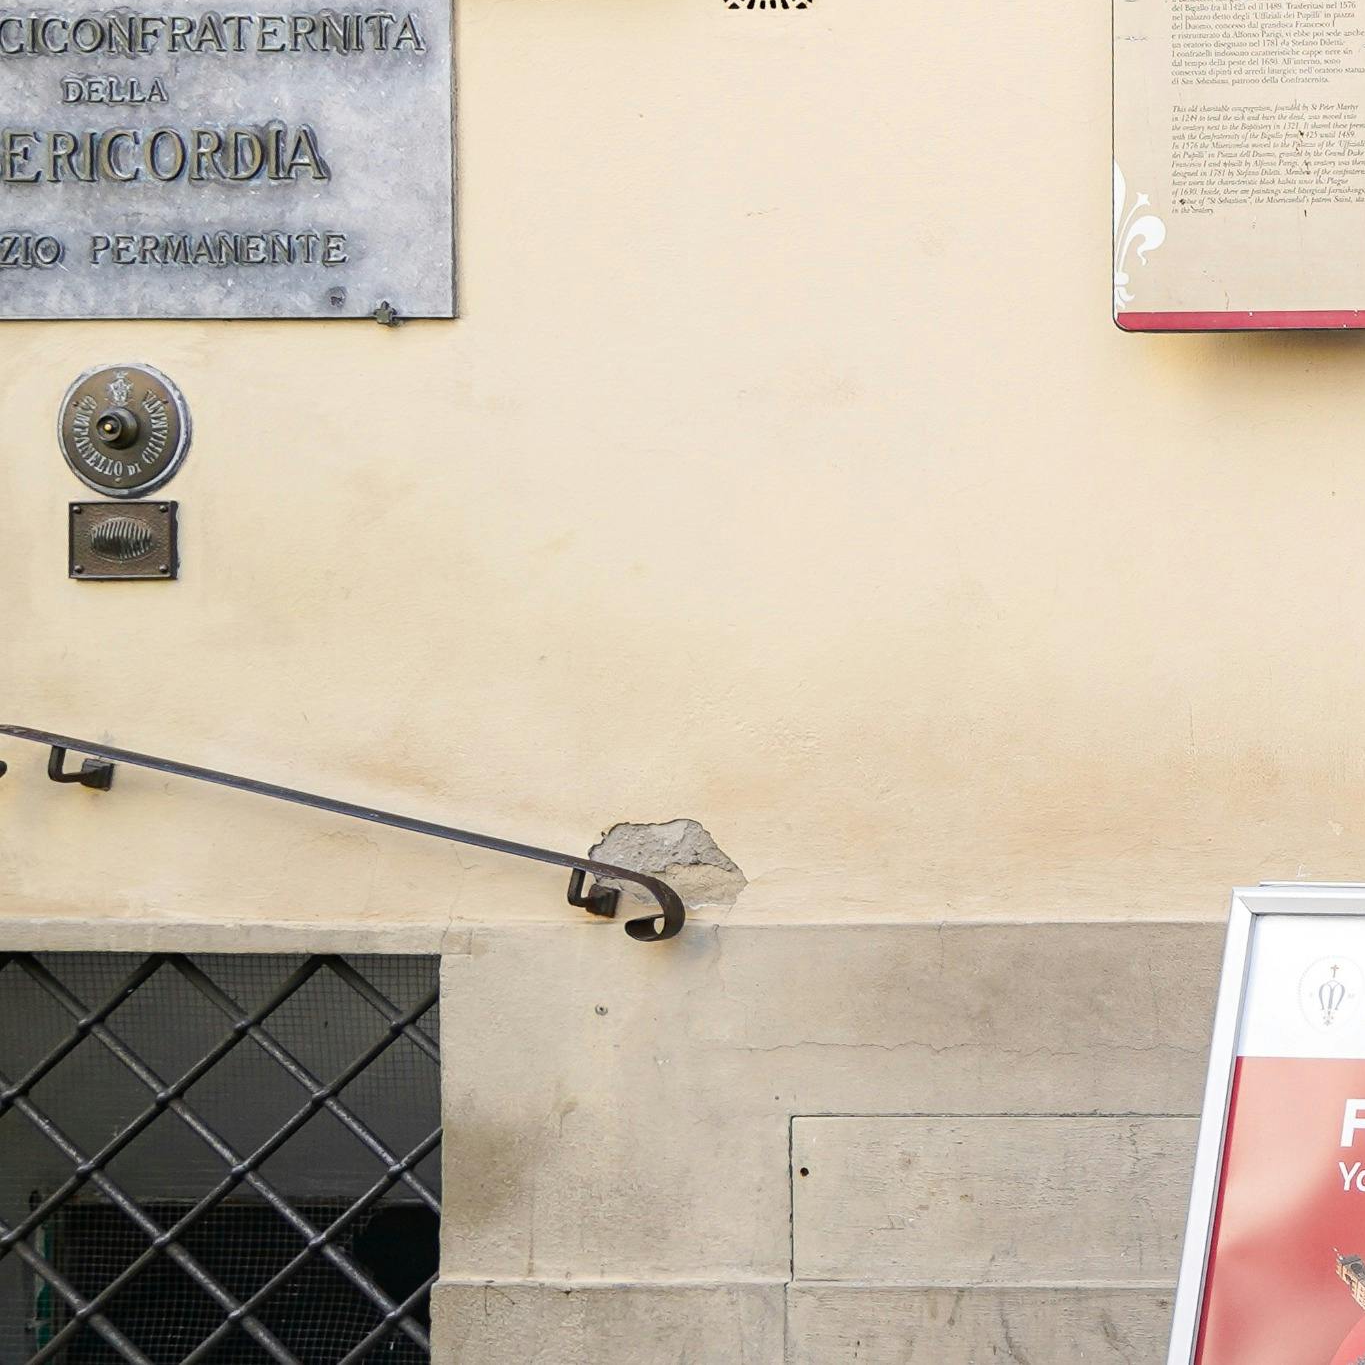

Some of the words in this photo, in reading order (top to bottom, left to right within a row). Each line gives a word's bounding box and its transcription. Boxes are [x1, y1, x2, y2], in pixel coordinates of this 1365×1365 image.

[1262, 39, 1278, 47] 1781
[62, 77, 169, 104] DELLA
[0, 128, 329, 183] ERICORDIA
[91, 233, 348, 265] PERMANENTE
[127, 463, 142, 476] DI
